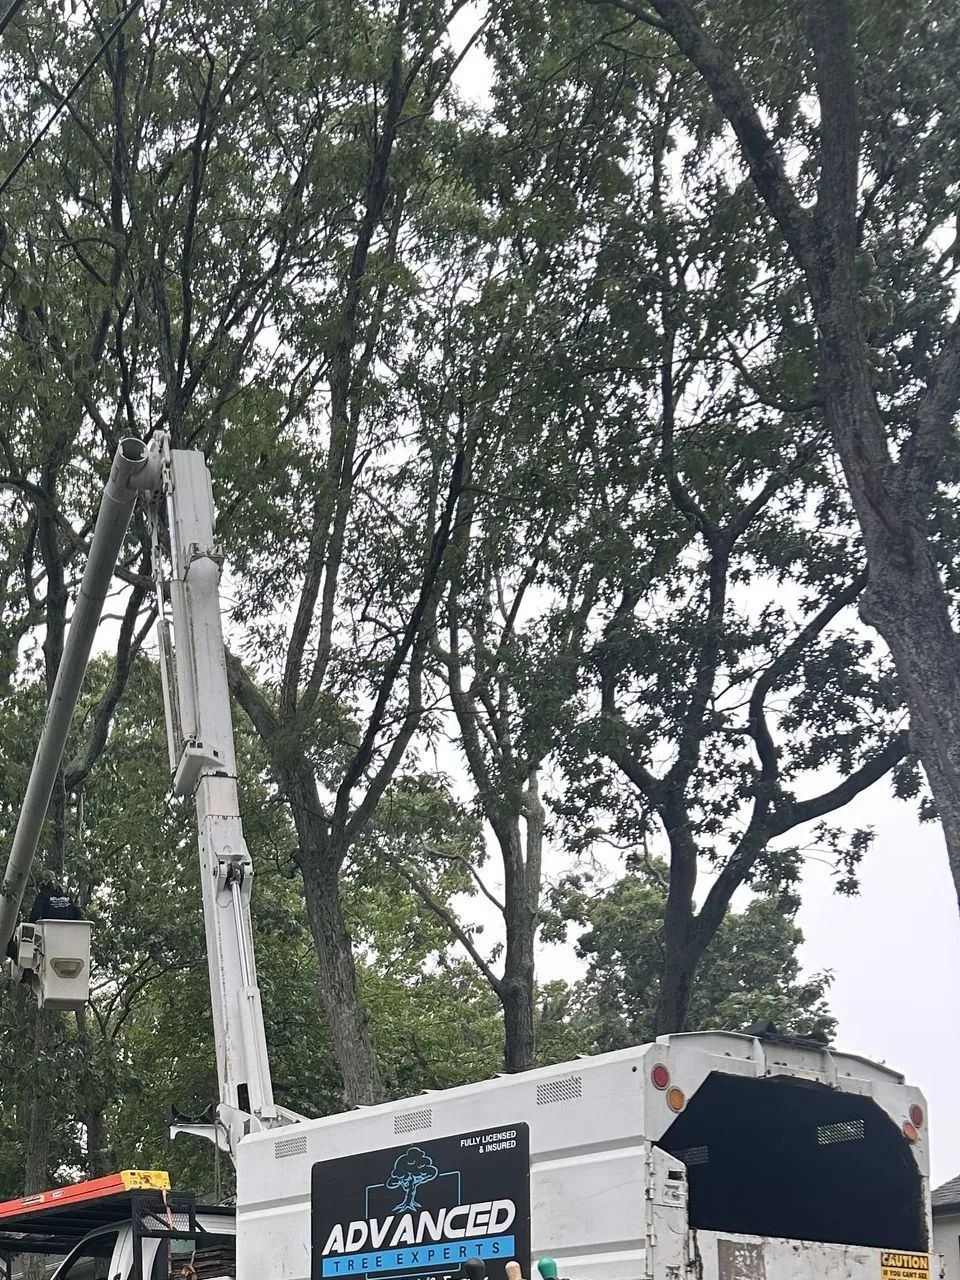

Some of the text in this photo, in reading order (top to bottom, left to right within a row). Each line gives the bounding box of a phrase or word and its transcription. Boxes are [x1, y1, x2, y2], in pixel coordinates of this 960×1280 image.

[460, 1130, 517, 1147] FULLY LICENSED
[479, 1139, 517, 1154] & INSURED
[321, 1198, 516, 1256] ADVANCED
[333, 1241, 500, 1273] TREE EXPERTS
[882, 1253, 927, 1269] CAUTION
